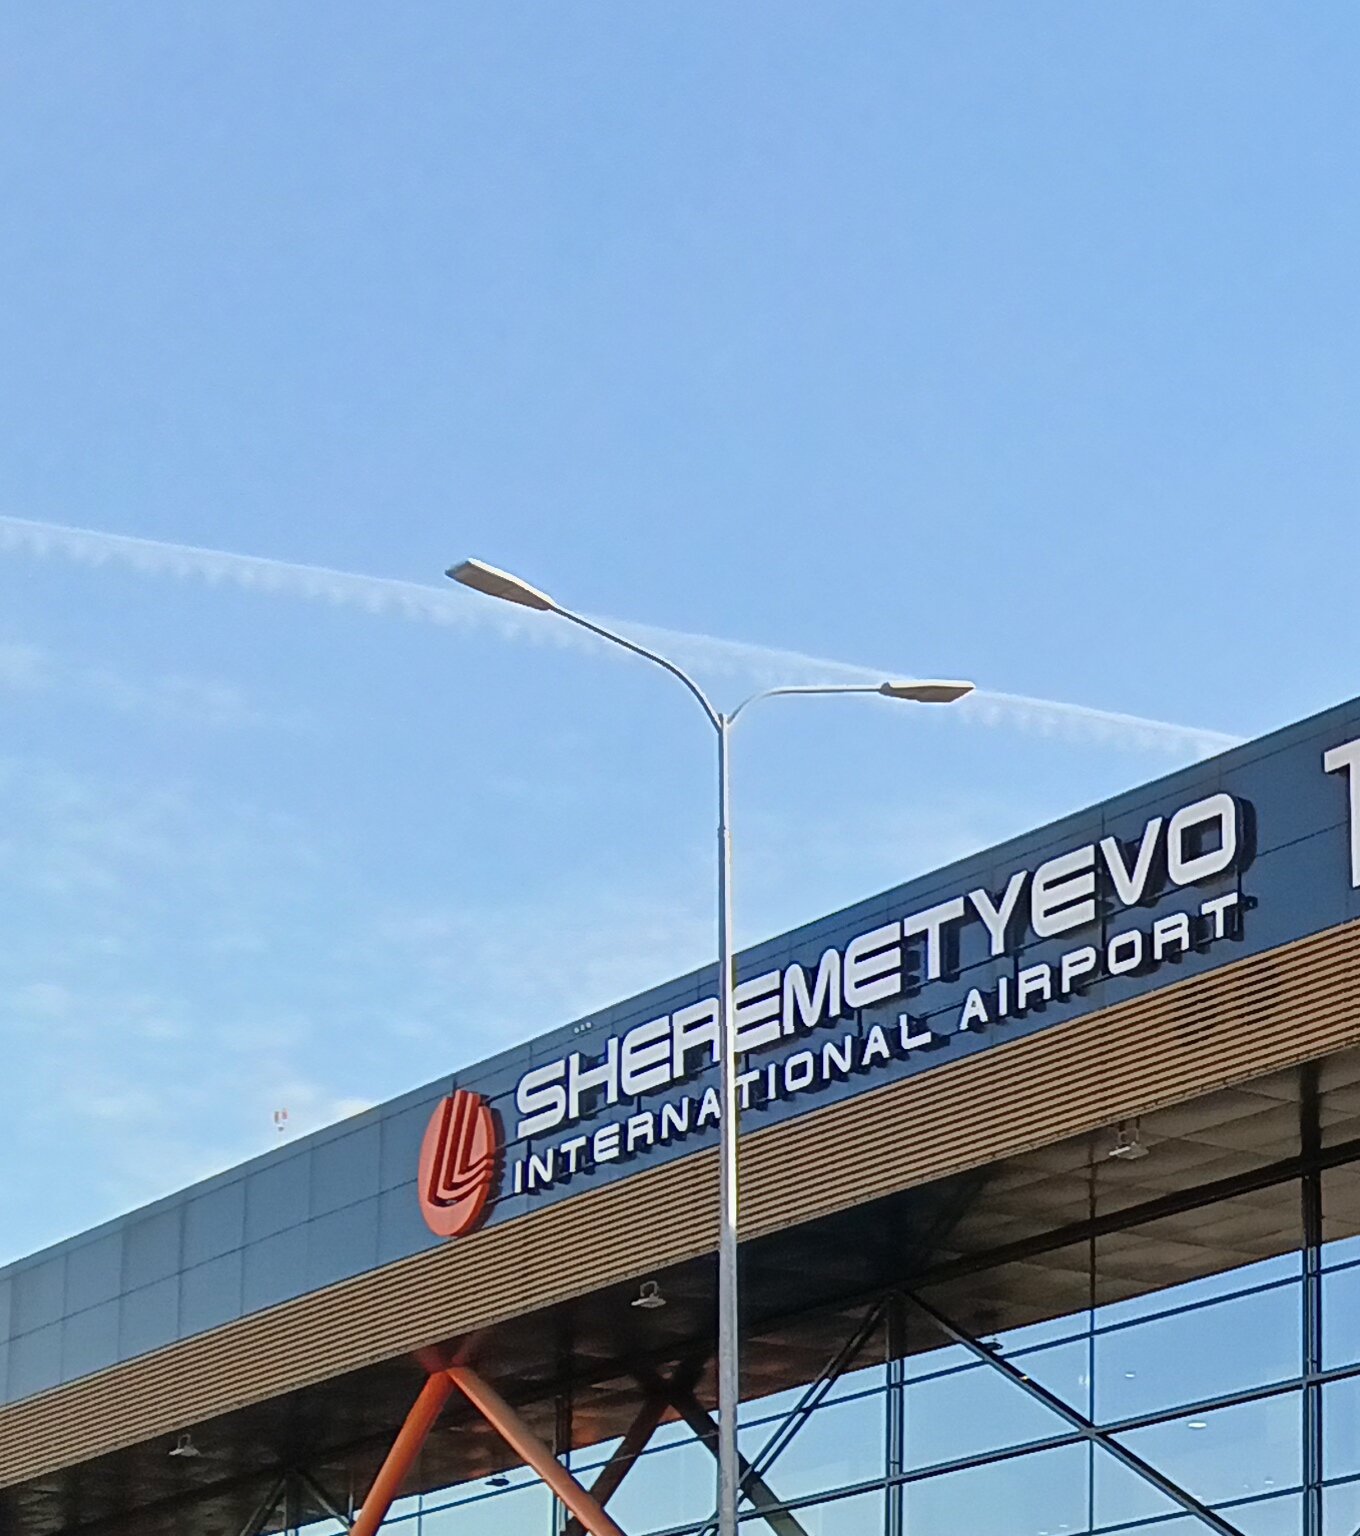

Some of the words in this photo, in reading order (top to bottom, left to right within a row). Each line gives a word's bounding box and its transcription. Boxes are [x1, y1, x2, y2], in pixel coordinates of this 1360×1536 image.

[511, 1012, 932, 1194] INTERNATIONAL
[958, 891, 1241, 1032] AIRPORT
[513, 791, 1238, 1139] SHEREMETYEVO
